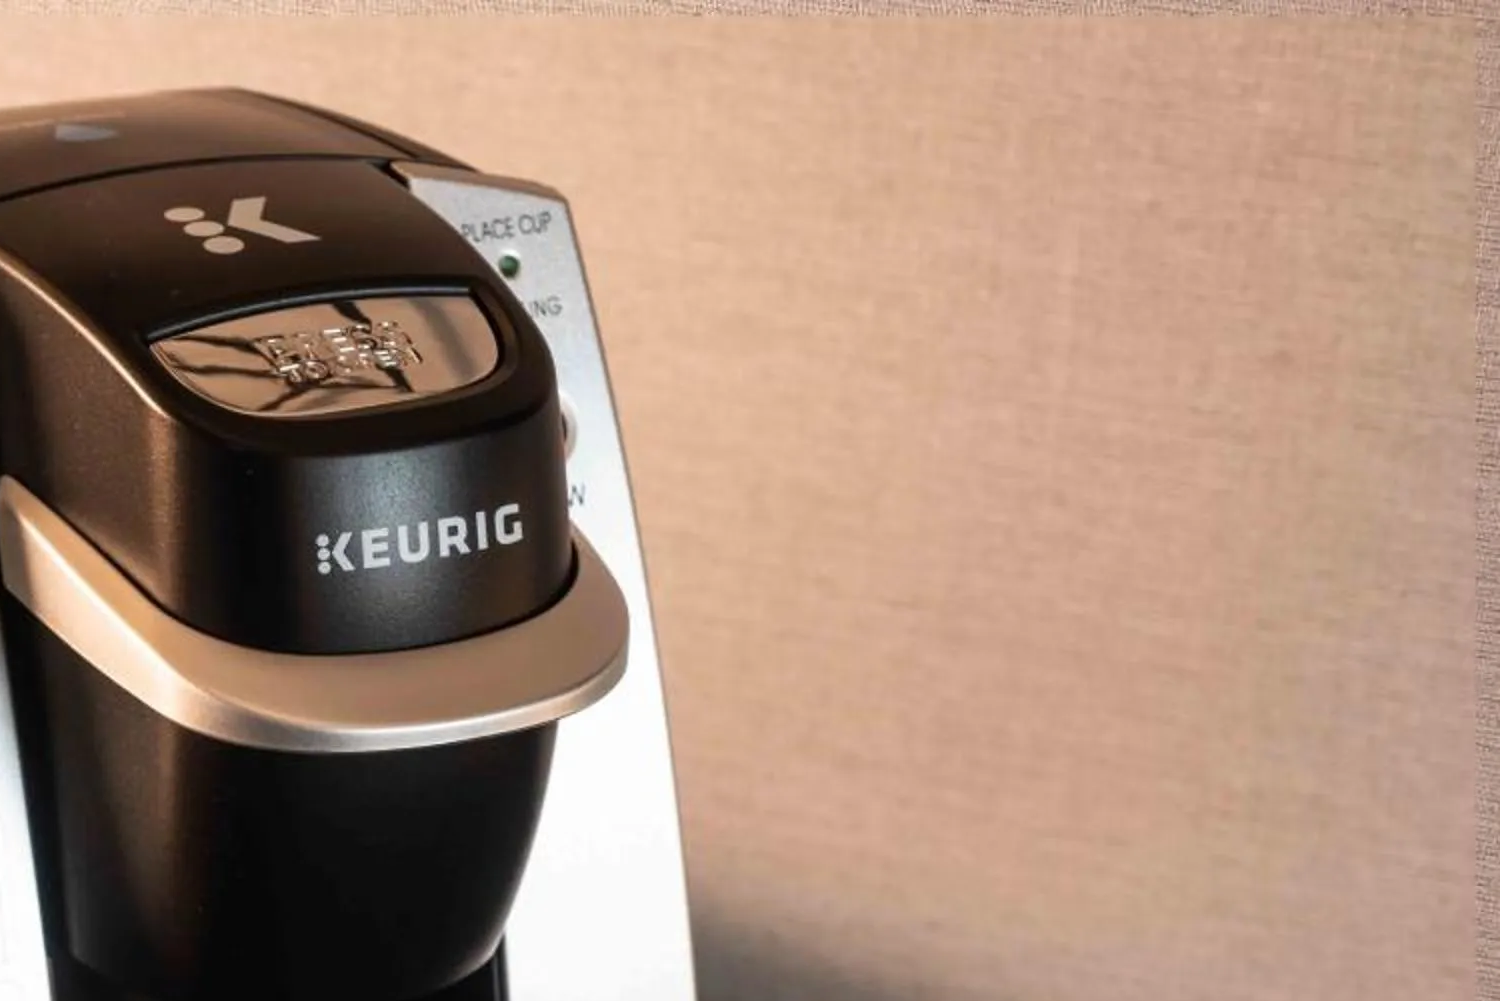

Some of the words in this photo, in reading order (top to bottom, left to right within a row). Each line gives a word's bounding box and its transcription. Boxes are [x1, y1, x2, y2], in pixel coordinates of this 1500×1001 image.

[461, 217, 514, 242] PLACE
[519, 211, 551, 235] CUP
[315, 503, 524, 575] KEURIG
